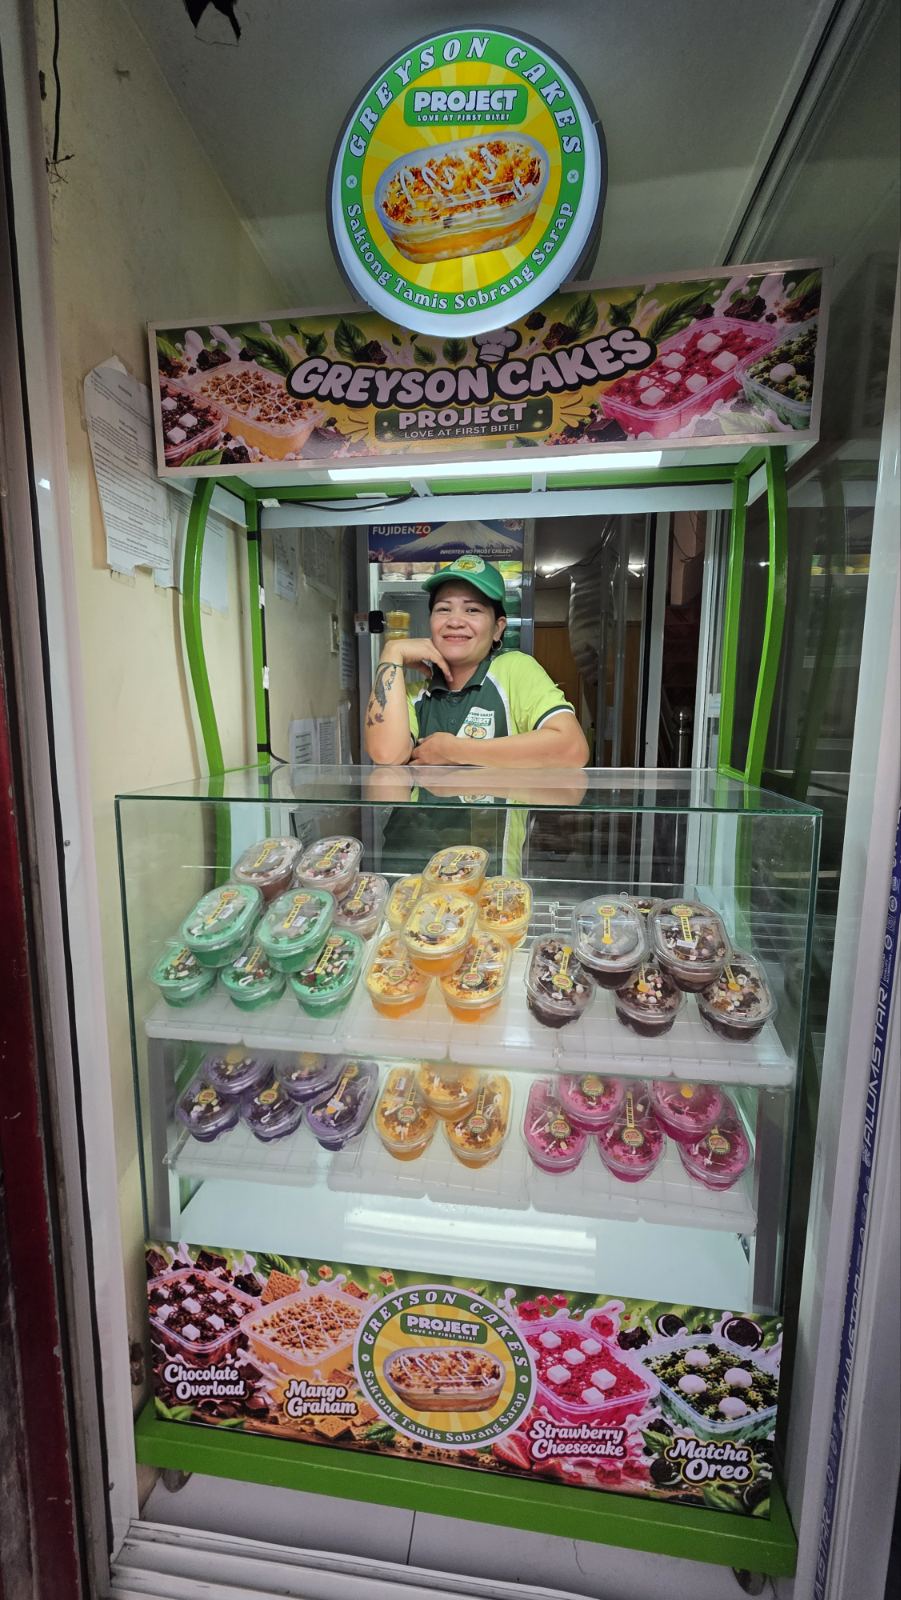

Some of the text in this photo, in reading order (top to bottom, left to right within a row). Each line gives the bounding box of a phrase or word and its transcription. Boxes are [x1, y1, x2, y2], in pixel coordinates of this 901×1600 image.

[349, 37, 582, 158] GREYSON CAKES
[414, 90, 518, 112] PROJECT
[417, 114, 439, 122] LOVE
[442, 114, 454, 122] AT
[457, 113, 482, 121] FIRST
[347, 202, 574, 310] Saktong Tamis Sobrang Sarap
[288, 328, 653, 405] GREYSON CAKES
[398, 402, 528, 430] PROJECT
[404, 423, 520, 439] LOVE AT FIRST BITE!
[372, 525, 431, 537] FUJIDENZO
[863, 987, 888, 1149] ALUMSTAR
[362, 1291, 529, 1368] GREYSON CAKES
[406, 1315, 480, 1336] PROJECT
[163, 1363, 239, 1384] Chocolate
[175, 1380, 245, 1400] Overload
[285, 1380, 347, 1402] Mango
[286, 1398, 358, 1417] Graham
[363, 1369, 527, 1442] Saktong Tamis Sobrang Sarap
[529, 1420, 624, 1443] Strawberry
[531, 1438, 625, 1458] Cheesecake
[668, 1439, 750, 1462] Matcha
[684, 1458, 750, 1481] Oreo
